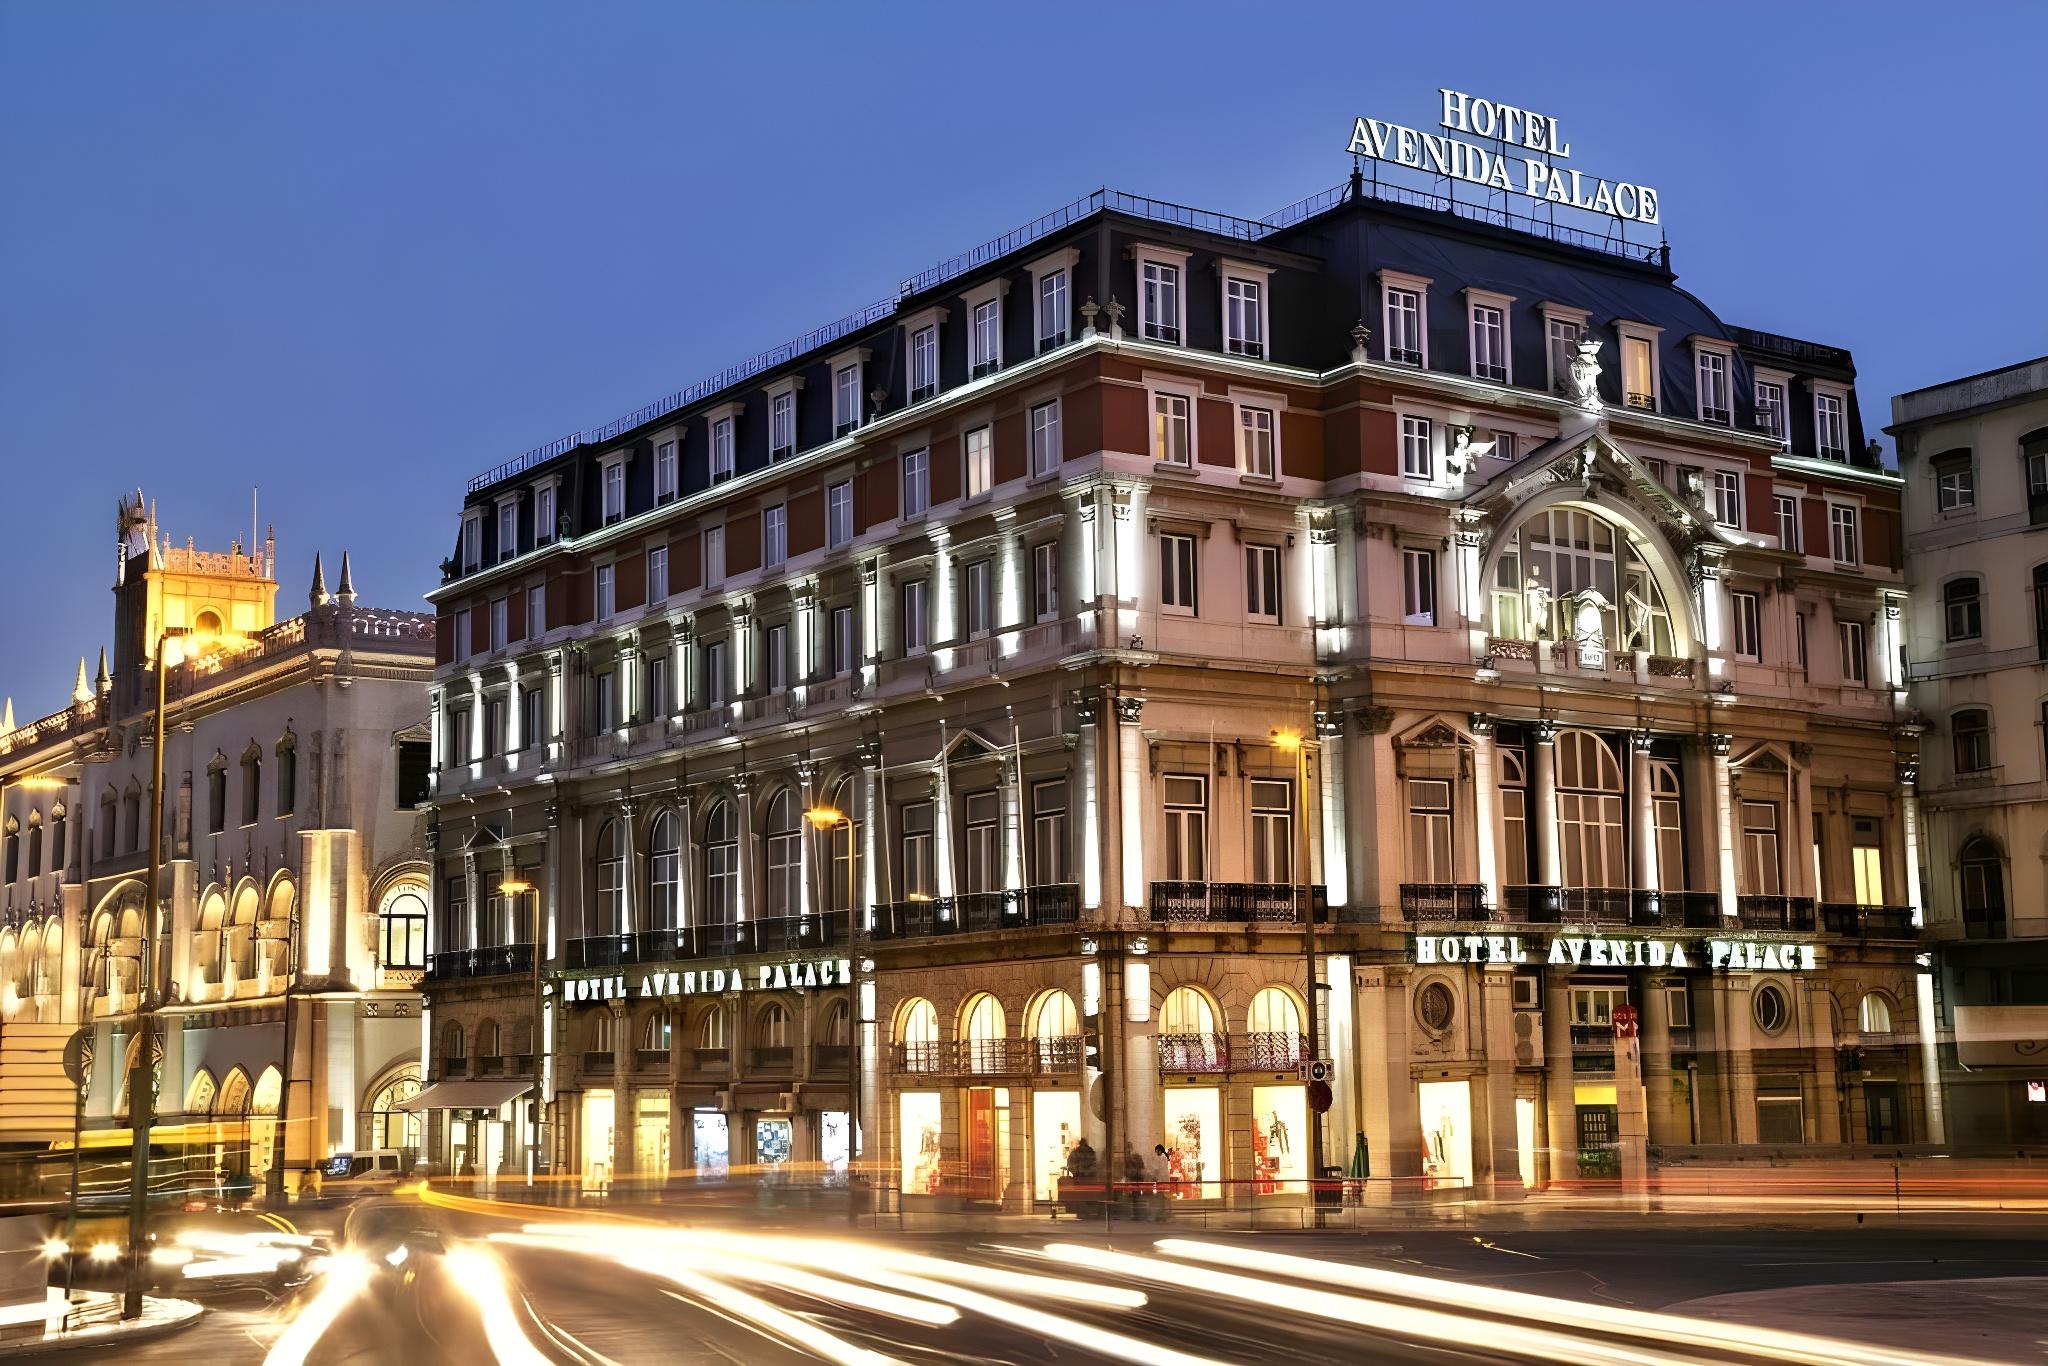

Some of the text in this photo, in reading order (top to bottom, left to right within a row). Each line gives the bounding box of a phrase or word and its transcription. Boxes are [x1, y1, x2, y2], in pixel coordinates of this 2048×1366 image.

[1438, 88, 1570, 158] HOTEL
[1346, 117, 1659, 224] AVENIDA PALACE
[640, 969, 743, 997] AVENIDA
[759, 959, 851, 989] PALACE
[1415, 936, 1816, 970] HOTEL AVENIDA PALACE
